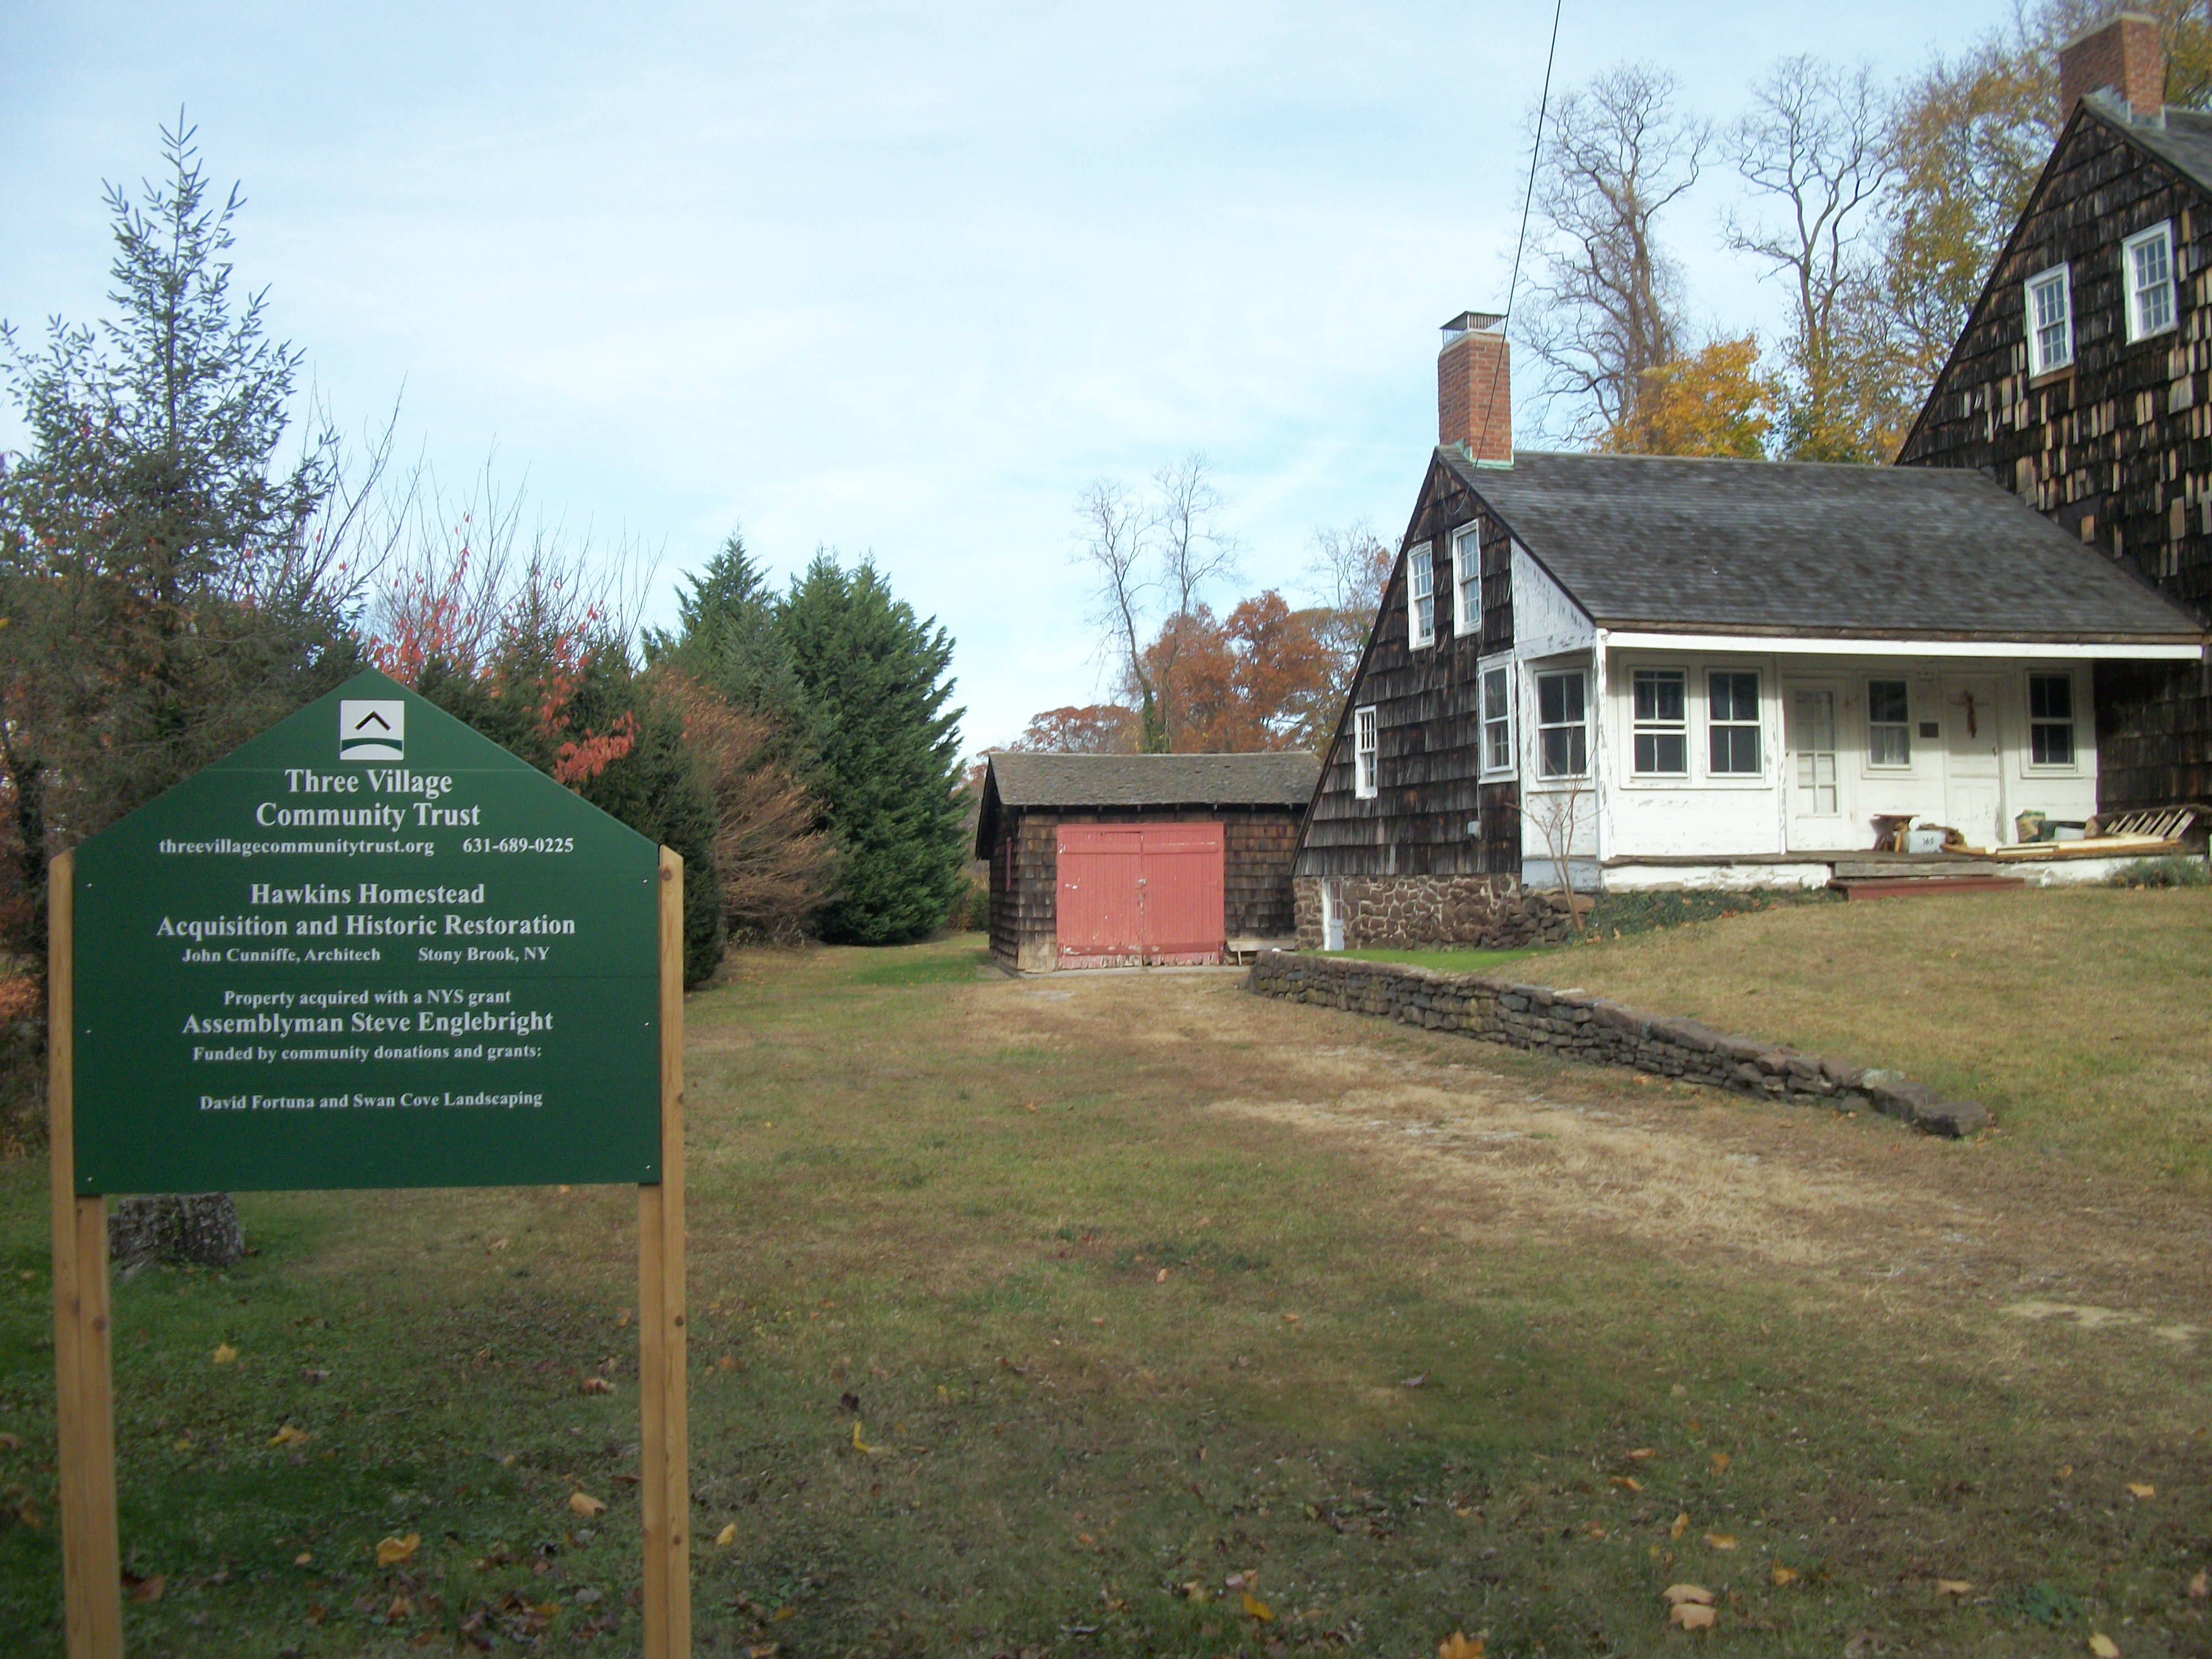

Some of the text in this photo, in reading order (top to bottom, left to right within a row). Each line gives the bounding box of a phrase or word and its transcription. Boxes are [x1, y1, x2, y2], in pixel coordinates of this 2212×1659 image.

[284, 769, 452, 800] Three Village
[256, 802, 481, 832] Community Trust
[159, 837, 573, 857] threevillagecommunitytrust.org 631-689-0225
[251, 884, 484, 904] Hawkins Homestead
[156, 914, 575, 941] Acquisition and Historic Restoration
[182, 947, 550, 964] John Cunniffe, Architech Stony Brook, NY
[225, 989, 511, 1009] Property acquired with a NYS grant
[182, 1011, 554, 1037] Assemblyman Steve Englebright
[194, 1045, 541, 1063] Funded by community donations and grants:
[201, 1091, 542, 1109] David Fortuna and Swan Cove Landscaping
